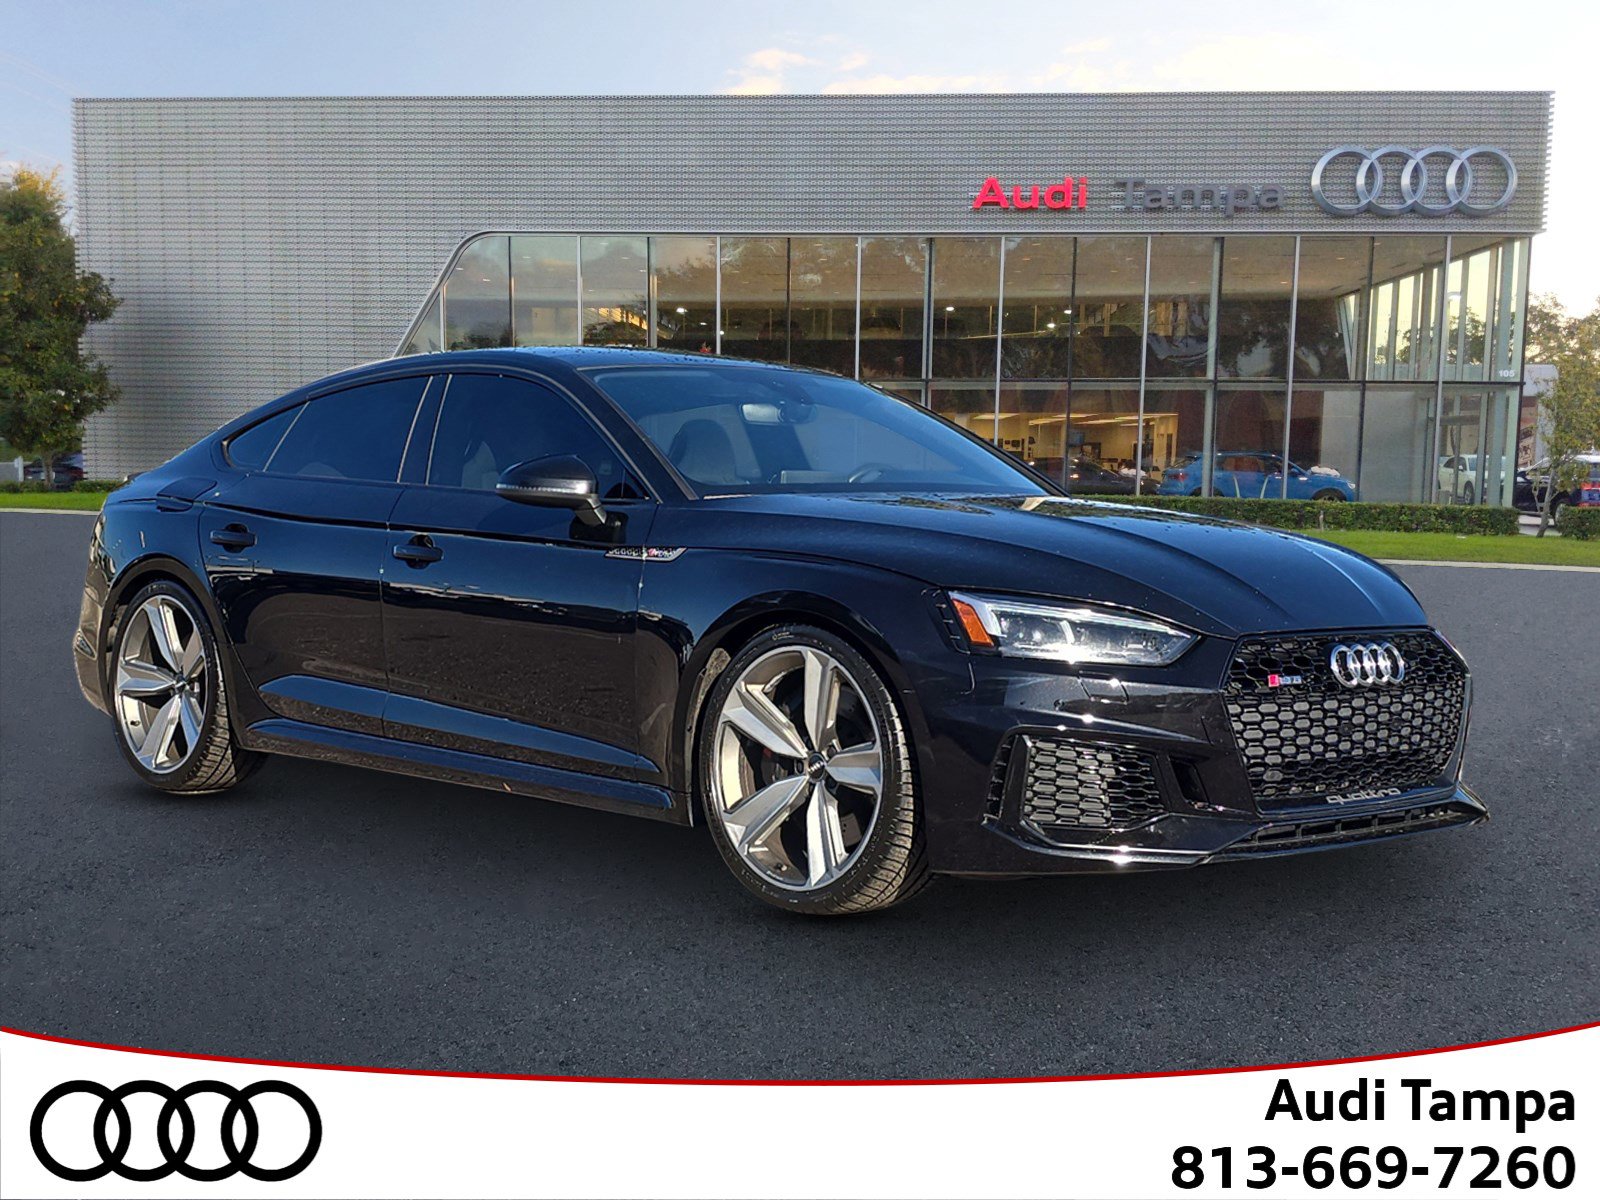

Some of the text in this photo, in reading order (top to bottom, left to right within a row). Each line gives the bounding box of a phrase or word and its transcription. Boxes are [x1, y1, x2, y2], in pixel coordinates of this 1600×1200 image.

[972, 176, 1285, 218] Audi Tampa
[1325, 787, 1401, 805] quattro
